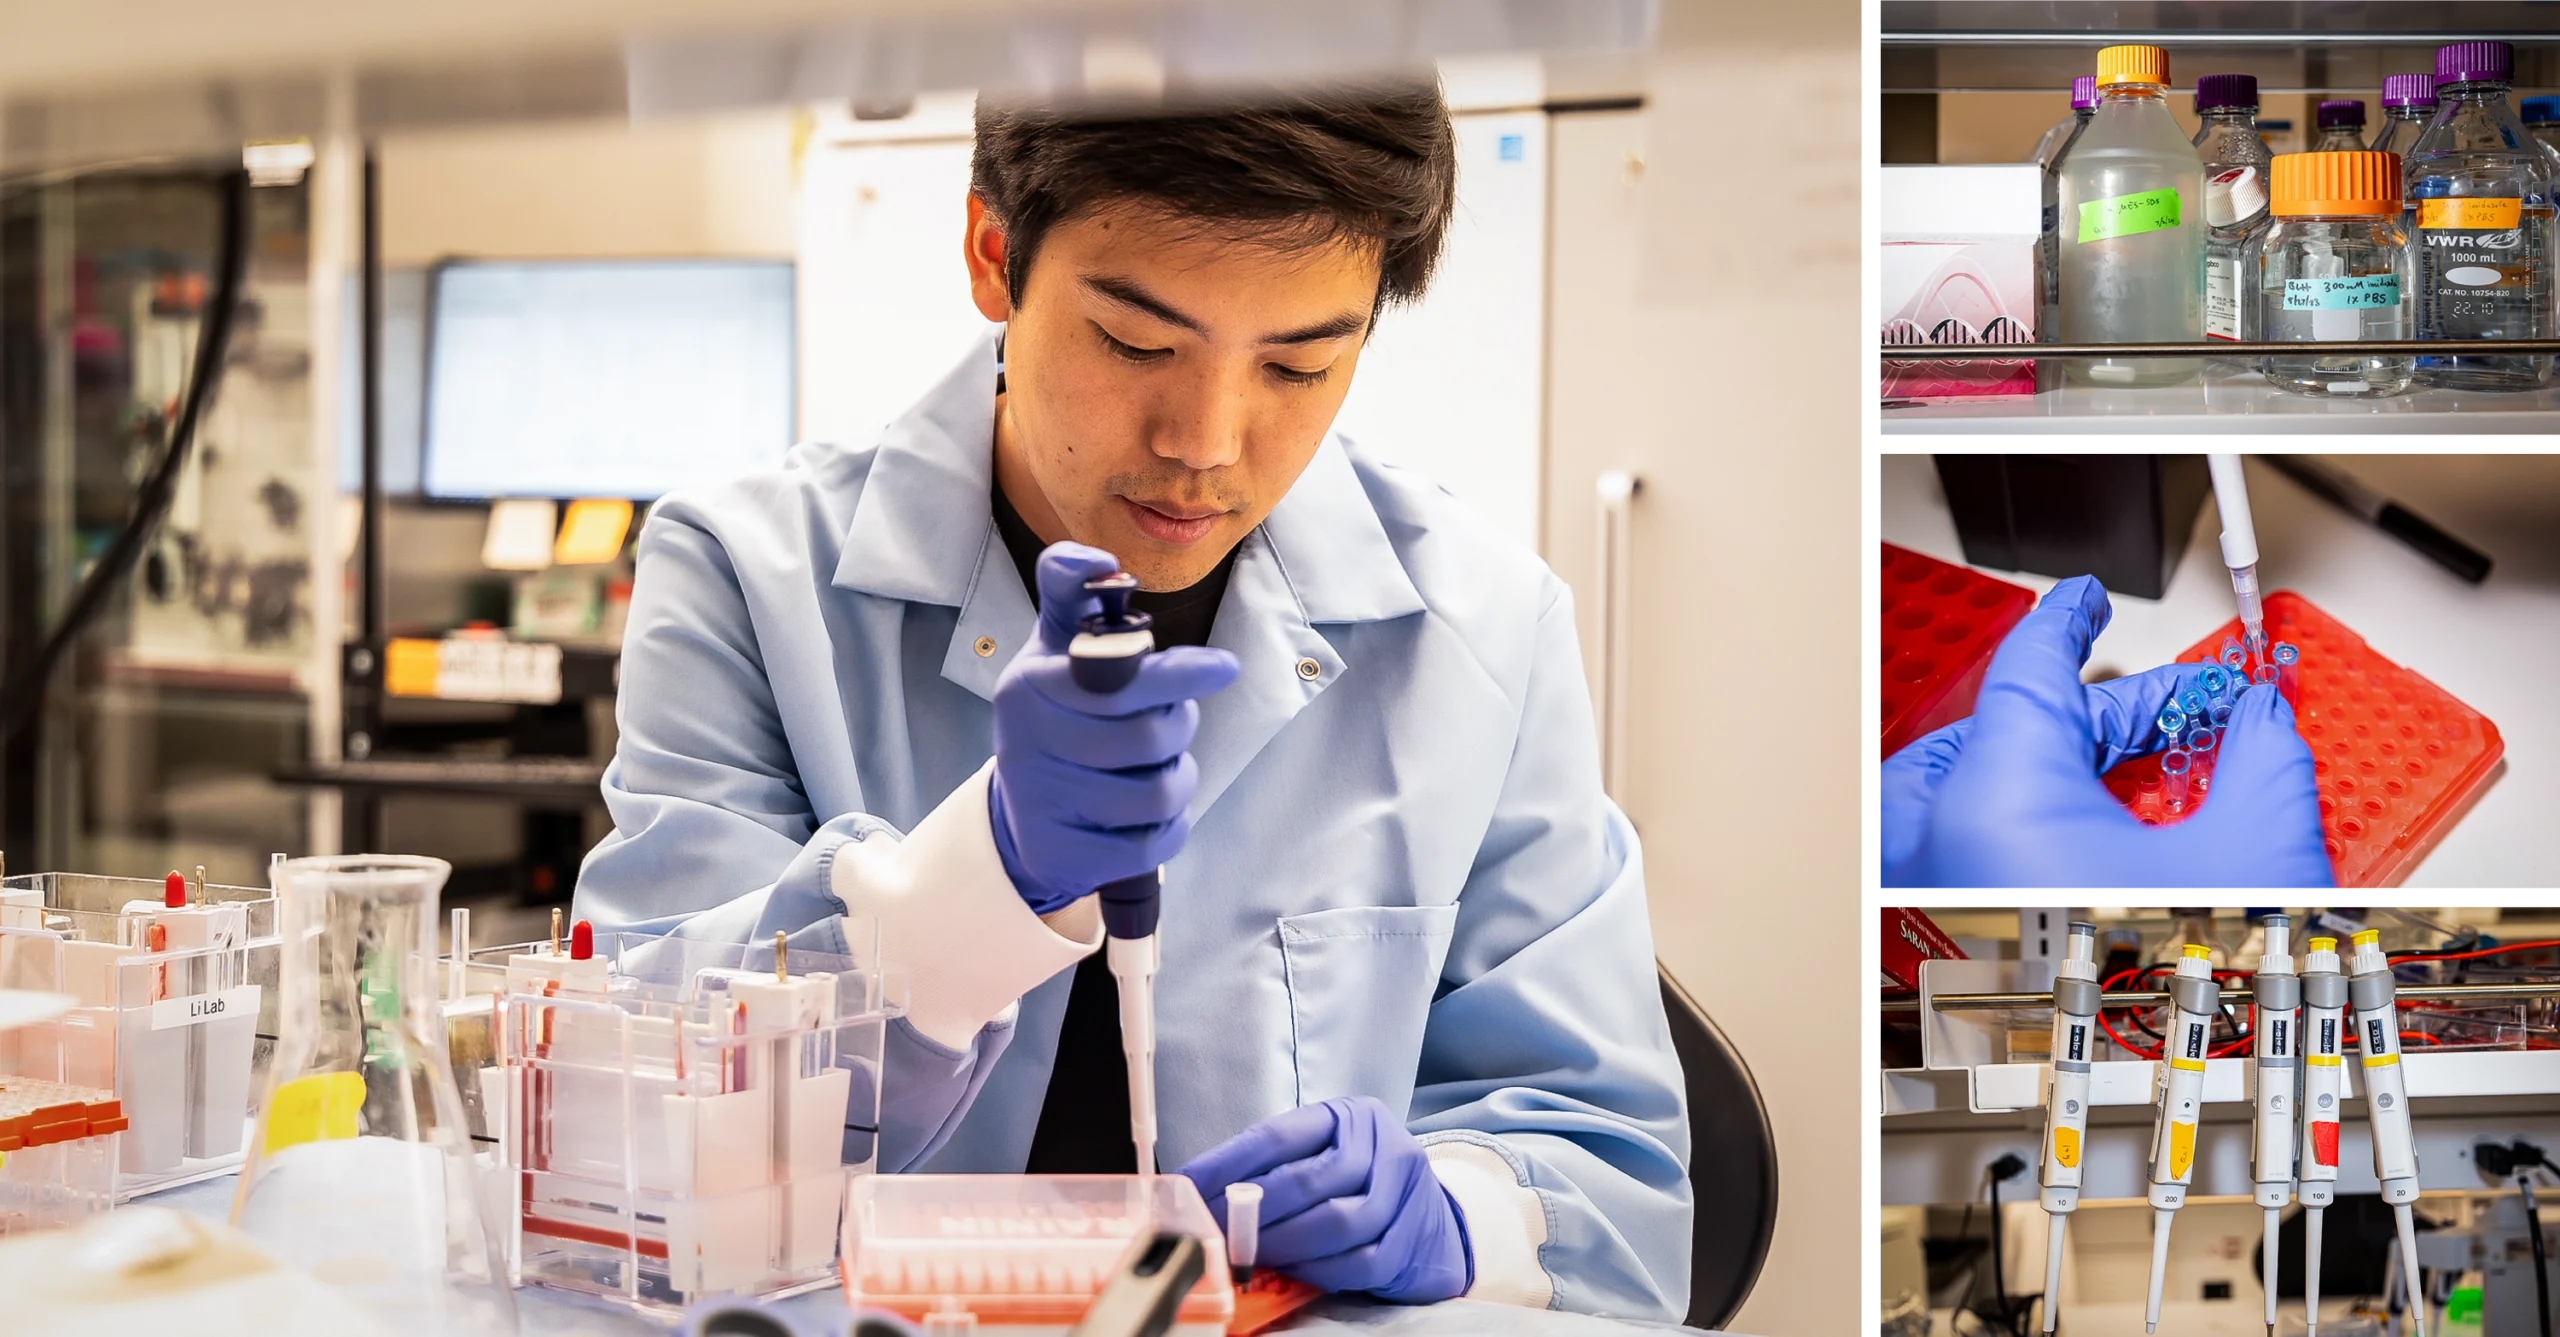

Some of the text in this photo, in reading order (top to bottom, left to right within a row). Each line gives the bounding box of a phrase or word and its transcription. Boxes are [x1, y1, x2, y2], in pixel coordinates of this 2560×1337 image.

[2426, 235, 2474, 248] VWR
[2451, 253, 2497, 263] 1000 mL
[2364, 293, 2387, 304] PBS
[2455, 289, 2469, 297] NO.
[2471, 289, 2510, 297] 10754-820
[1900, 919, 1931, 958] SARAN
[191, 998, 225, 1017] Li Lab
